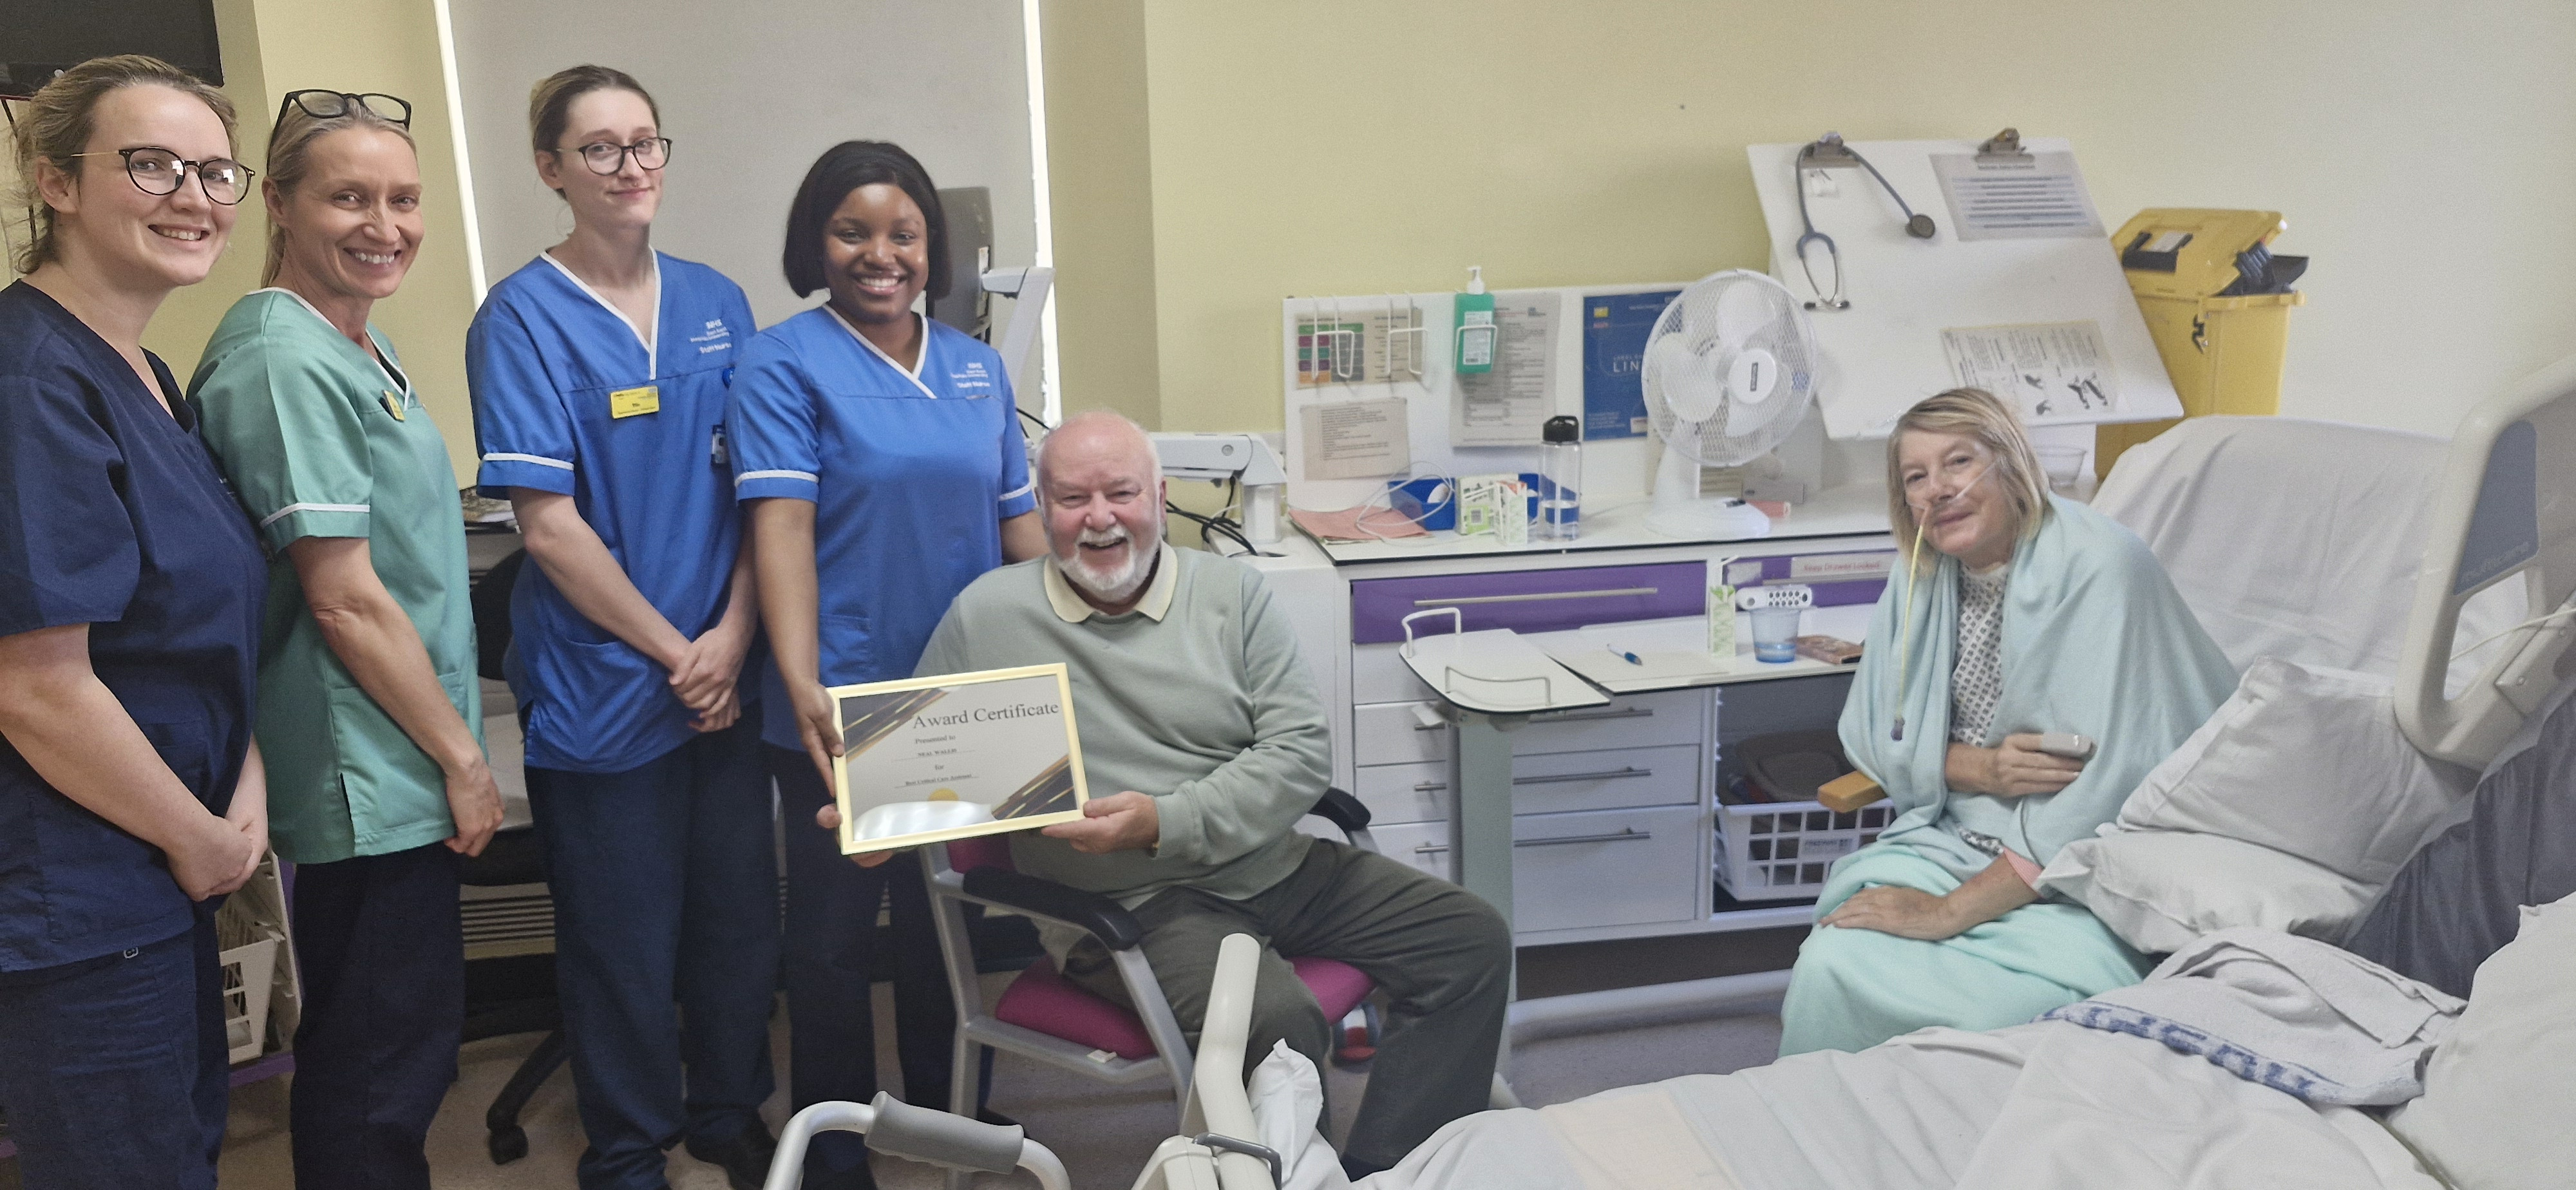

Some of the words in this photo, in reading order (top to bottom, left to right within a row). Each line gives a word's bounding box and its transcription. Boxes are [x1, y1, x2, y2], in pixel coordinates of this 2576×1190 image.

[1613, 361, 1640, 373] LIN
[913, 710, 968, 729] Award
[974, 703, 1059, 722] Certificate
[915, 735, 947, 744] Presented
